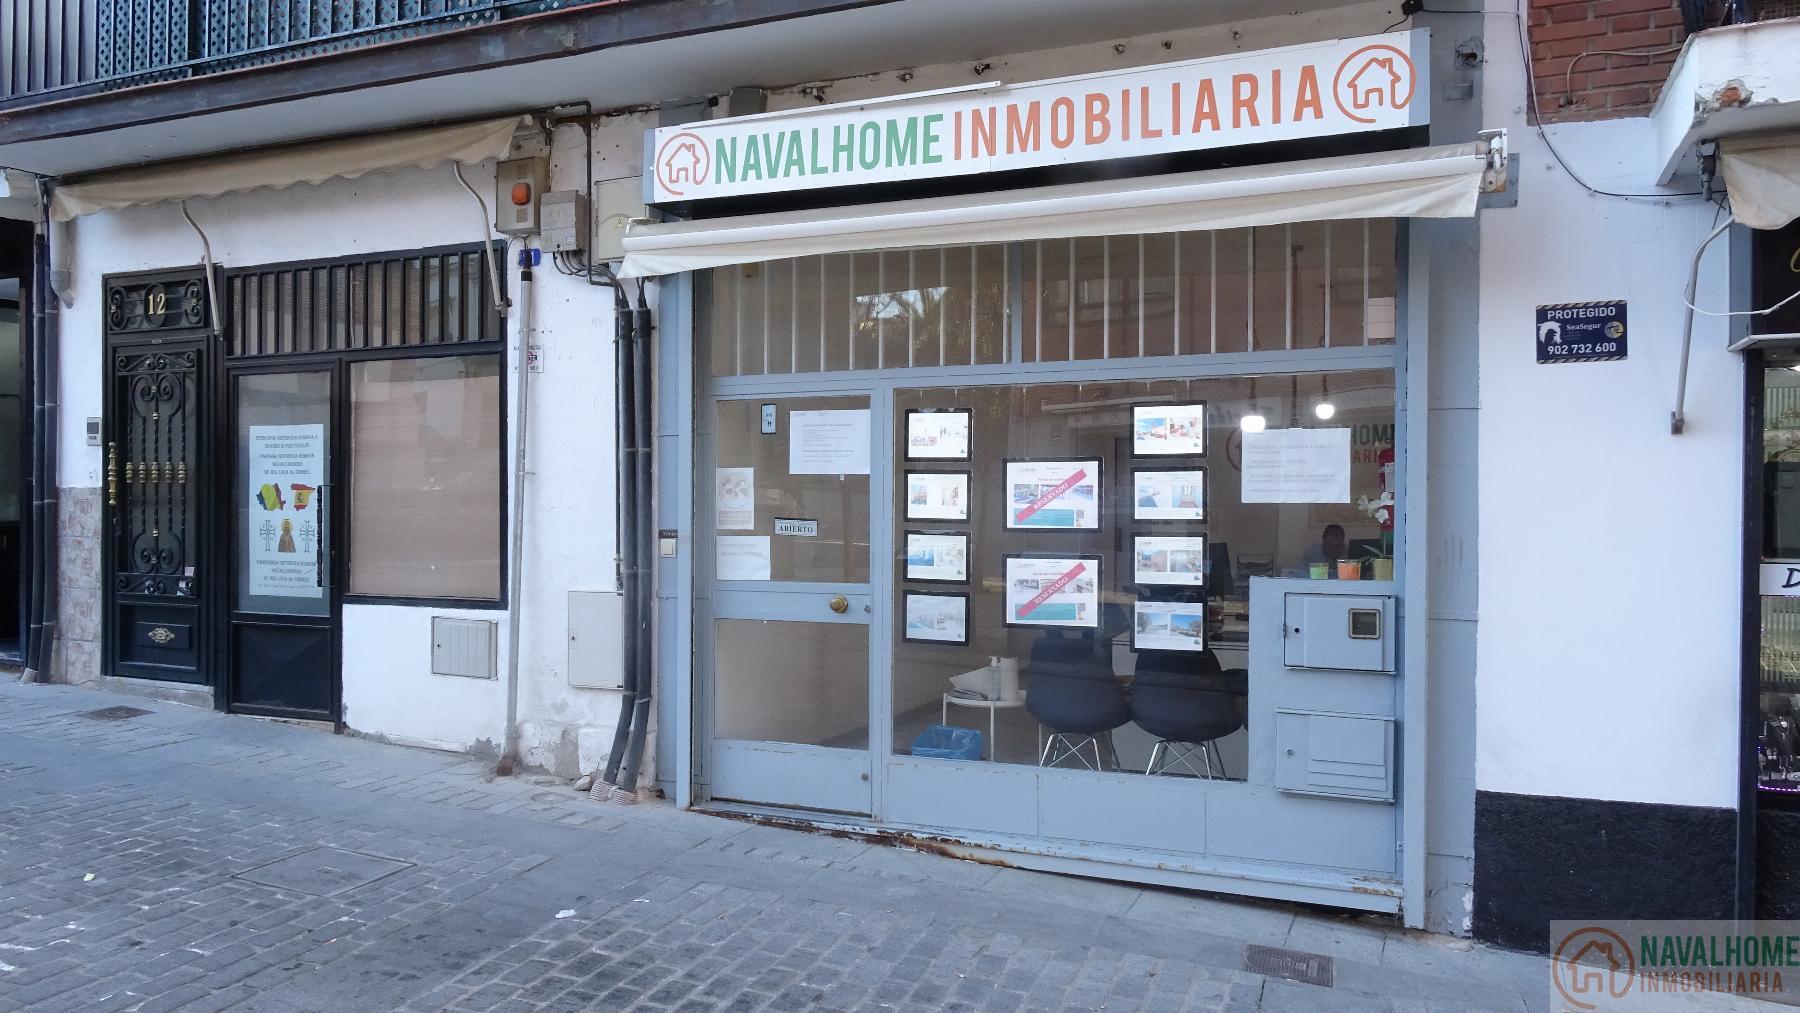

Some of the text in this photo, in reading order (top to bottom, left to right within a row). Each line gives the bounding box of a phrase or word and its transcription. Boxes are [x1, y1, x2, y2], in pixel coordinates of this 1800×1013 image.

[715, 64, 1324, 184] NAVALHOME INMOBILIARIA
[148, 293, 166, 315] 12
[1547, 306, 1616, 320] PROTEGIDO
[1547, 342, 1617, 355] 902 732 600
[1033, 483, 1068, 511] RESERVADO
[778, 525, 814, 533] ABIERTO
[1034, 577, 1068, 605] RESERVADO
